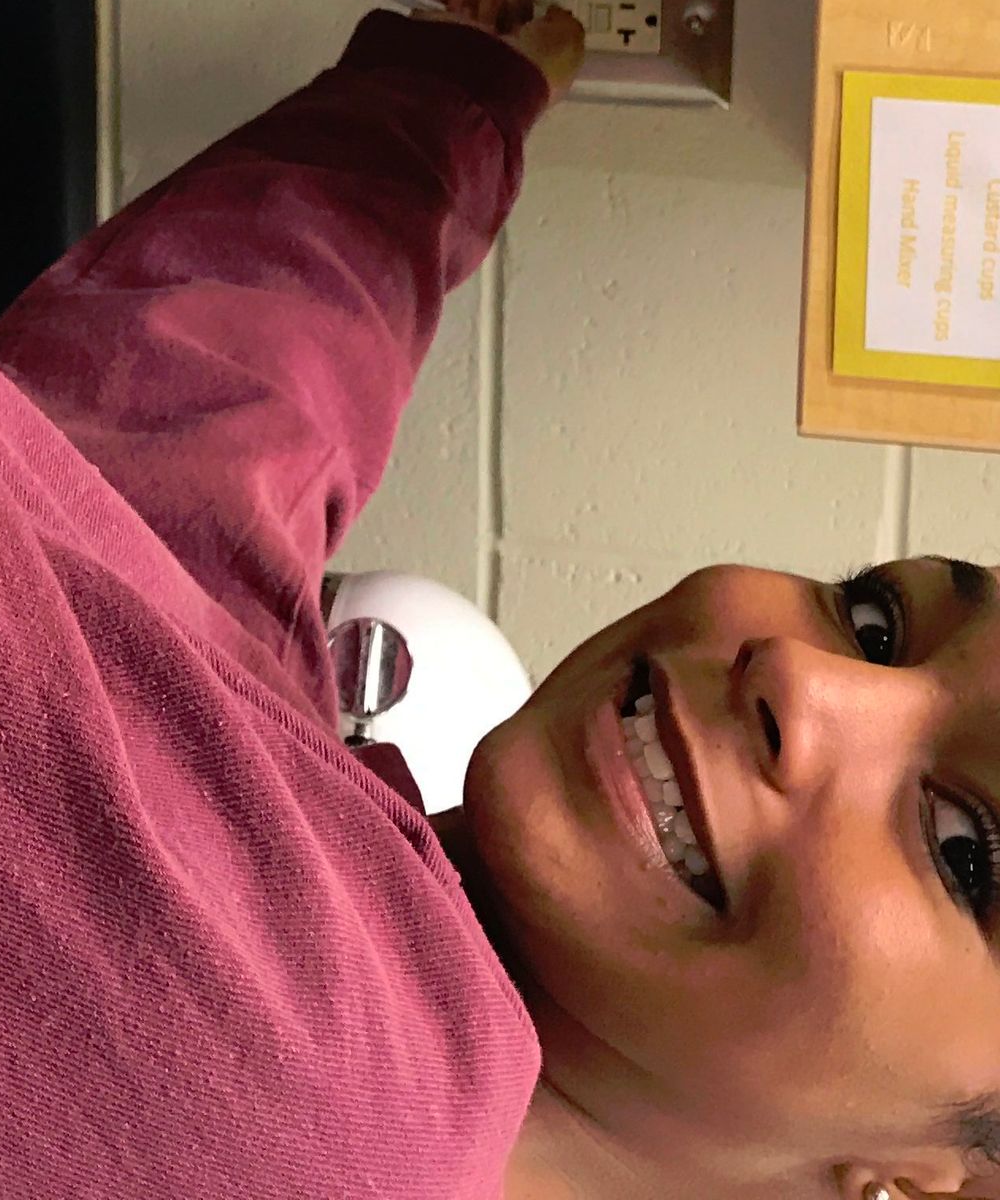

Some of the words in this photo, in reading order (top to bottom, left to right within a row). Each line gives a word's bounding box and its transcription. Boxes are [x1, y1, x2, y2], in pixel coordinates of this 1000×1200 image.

[944, 131, 966, 189] Liquid
[901, 178, 920, 229] Hand
[983, 178, 1000, 254] Custard
[897, 235, 917, 288] Mixer
[934, 194, 958, 293] measuring
[978, 258, 996, 301] cups
[932, 298, 951, 341] cups
